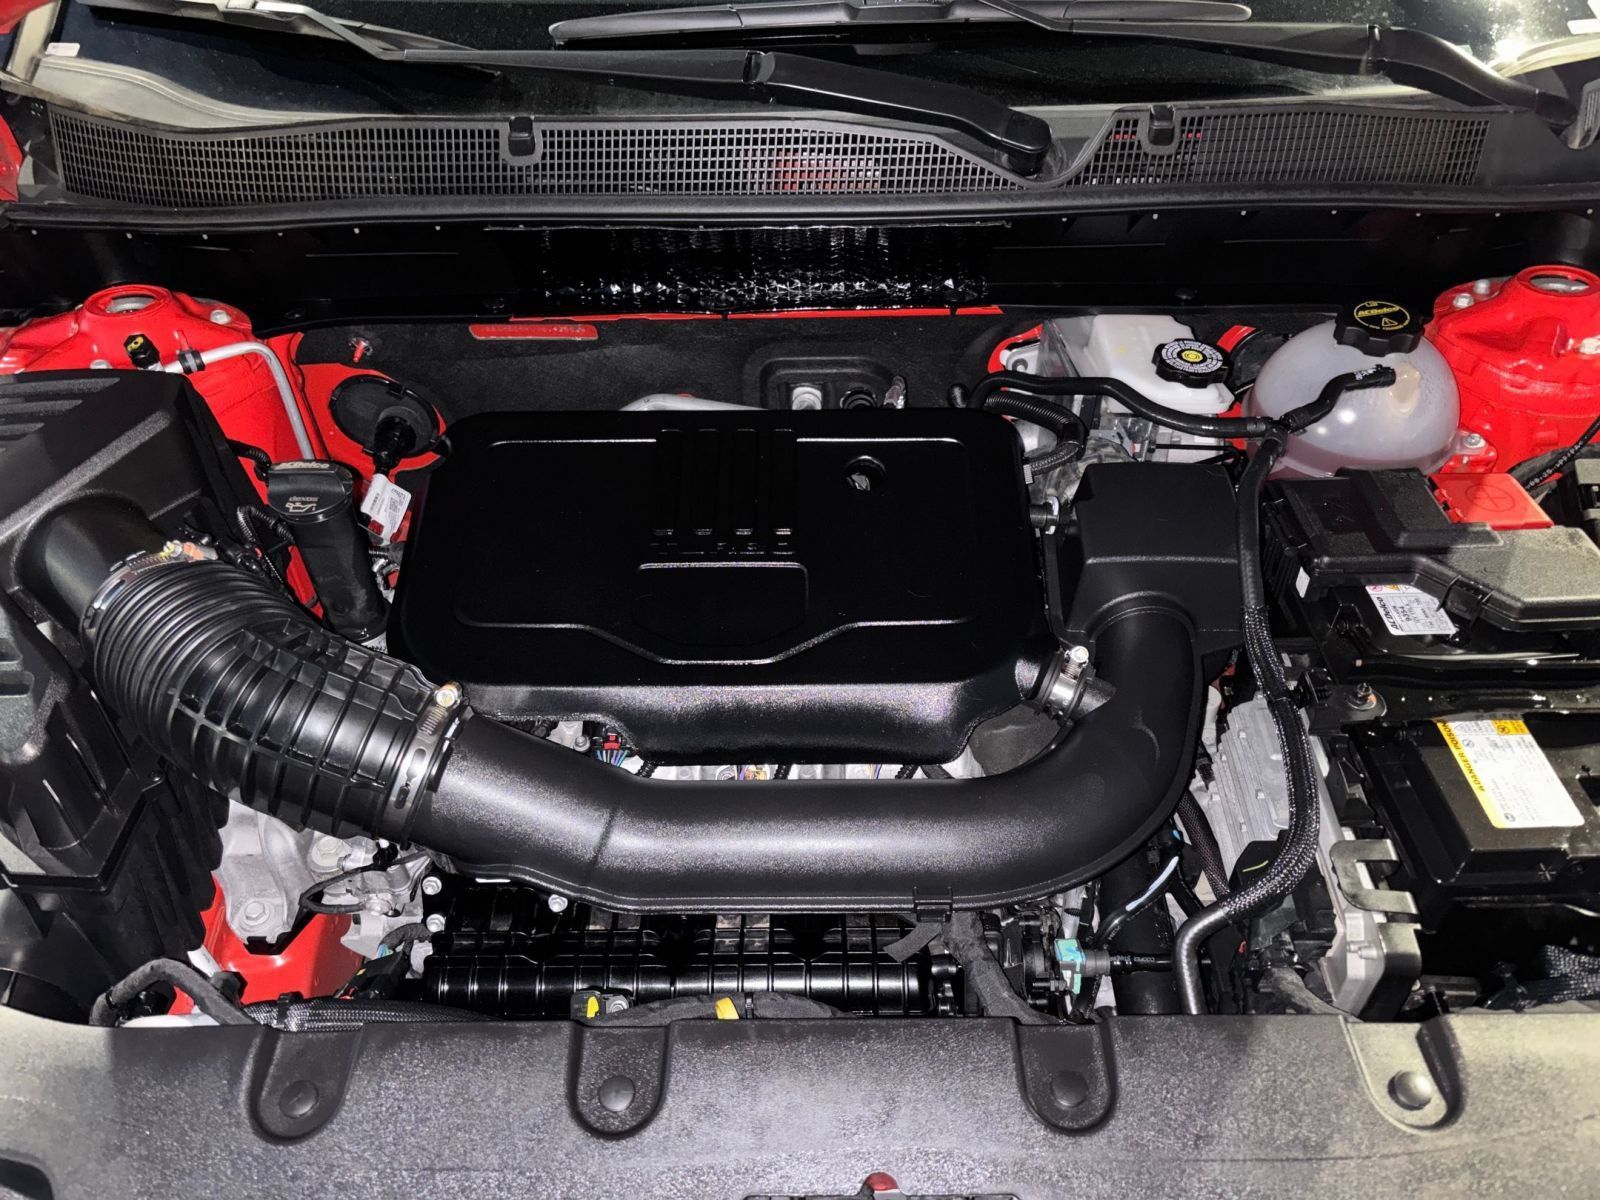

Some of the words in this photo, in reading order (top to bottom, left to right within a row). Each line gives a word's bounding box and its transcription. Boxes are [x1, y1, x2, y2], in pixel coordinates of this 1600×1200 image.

[1357, 306, 1400, 318] ACDelco
[275, 461, 330, 470] ACDelco
[1376, 596, 1400, 630] ACDelco
[1438, 718, 1461, 753] POISON
[1458, 751, 1482, 786] DANGER
